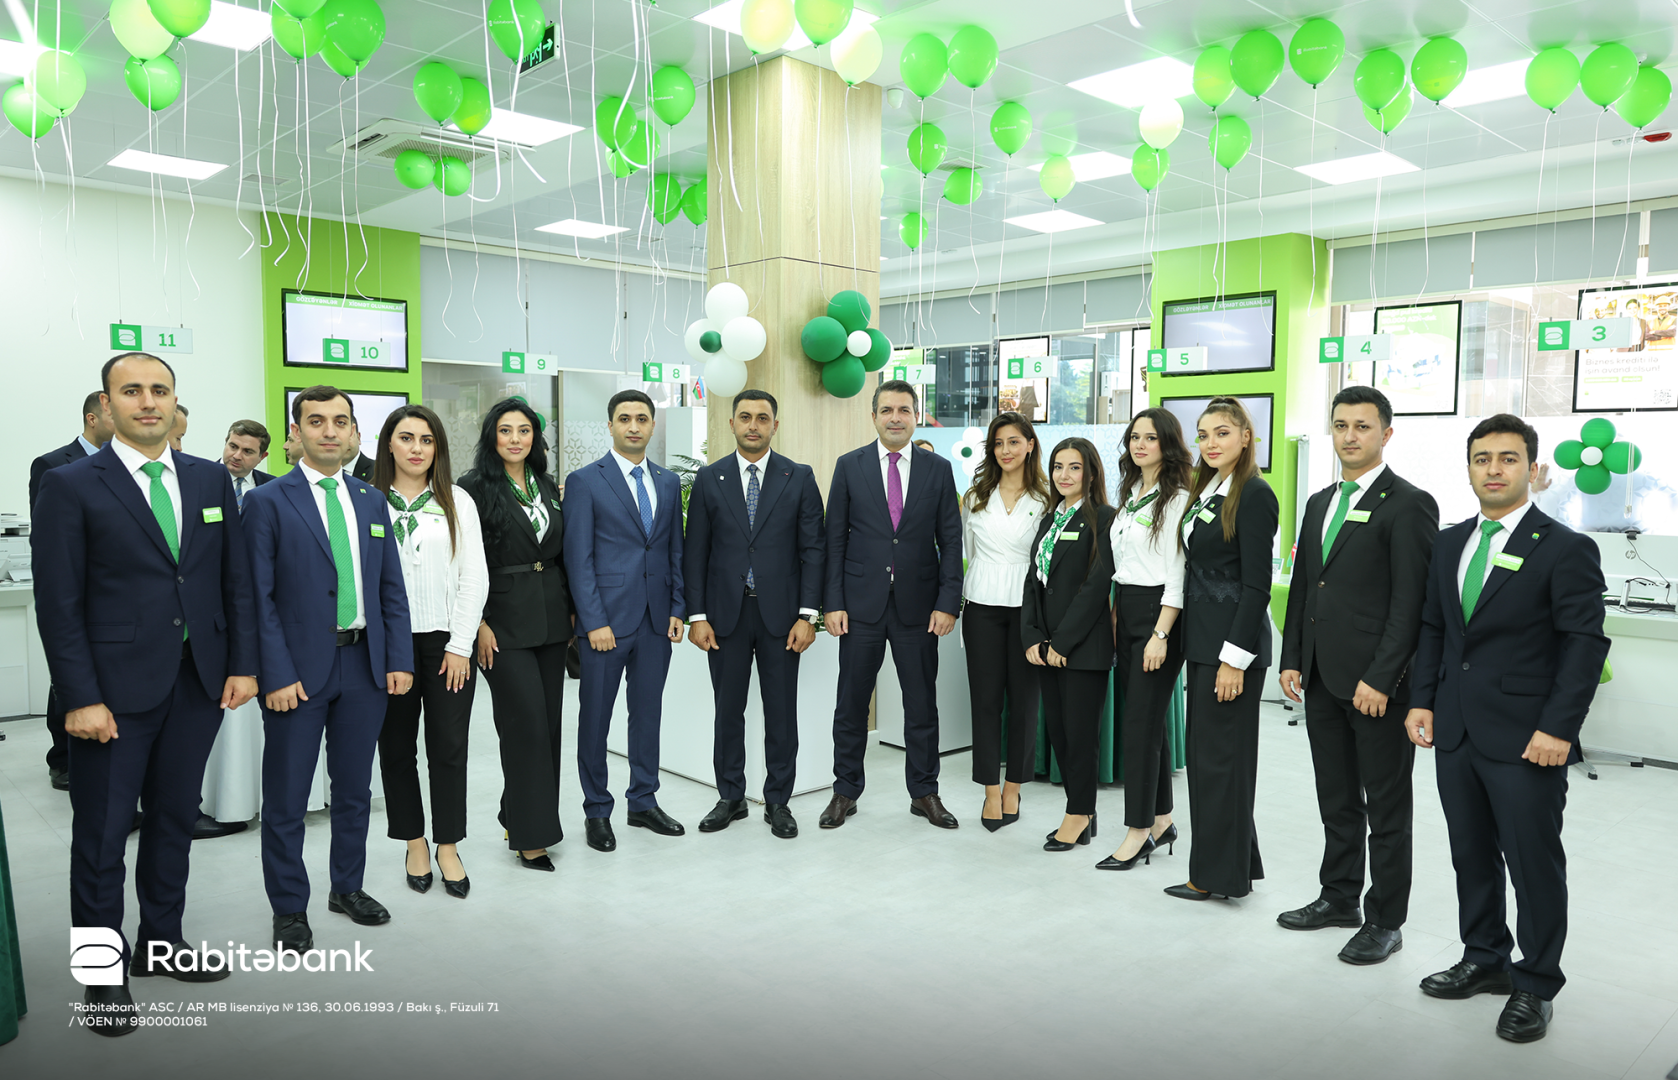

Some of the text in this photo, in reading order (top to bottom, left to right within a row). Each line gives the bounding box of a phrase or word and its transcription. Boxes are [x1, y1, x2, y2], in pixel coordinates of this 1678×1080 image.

[1591, 325, 1606, 341] 3
[158, 333, 177, 347] 11
[360, 346, 379, 360] 10
[1360, 340, 1372, 355] 4
[537, 358, 546, 371] 9
[1180, 352, 1190, 366] 5
[1585, 358, 1614, 366] Biznes
[672, 368, 681, 379] 8
[1033, 361, 1042, 373] 6
[915, 369, 922, 380] 7
